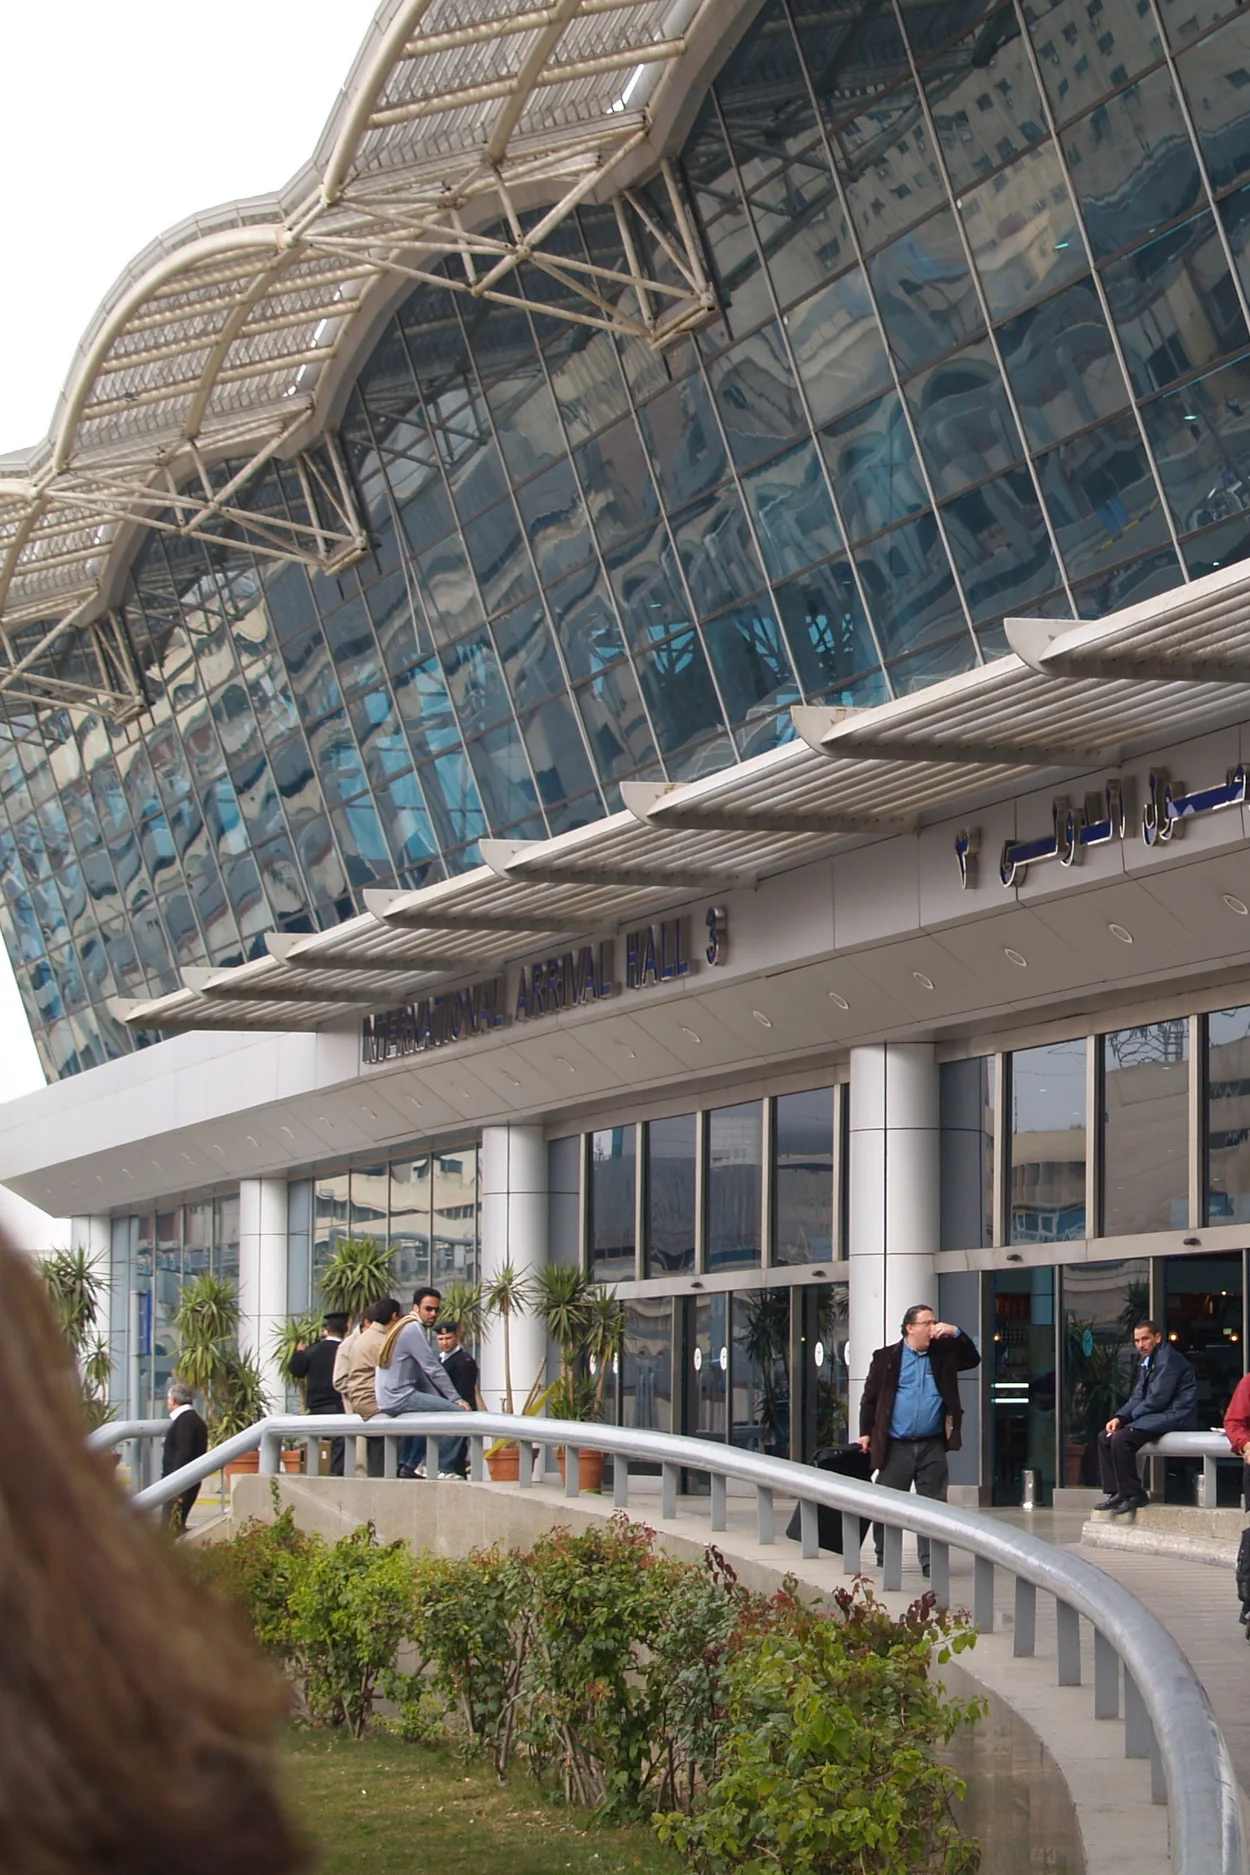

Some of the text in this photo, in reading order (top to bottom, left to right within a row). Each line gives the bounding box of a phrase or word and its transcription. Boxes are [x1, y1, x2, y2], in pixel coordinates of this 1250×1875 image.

[515, 940, 621, 1023] ARRIVAL
[626, 916, 692, 989] HALL
[706, 905, 727, 967] 3
